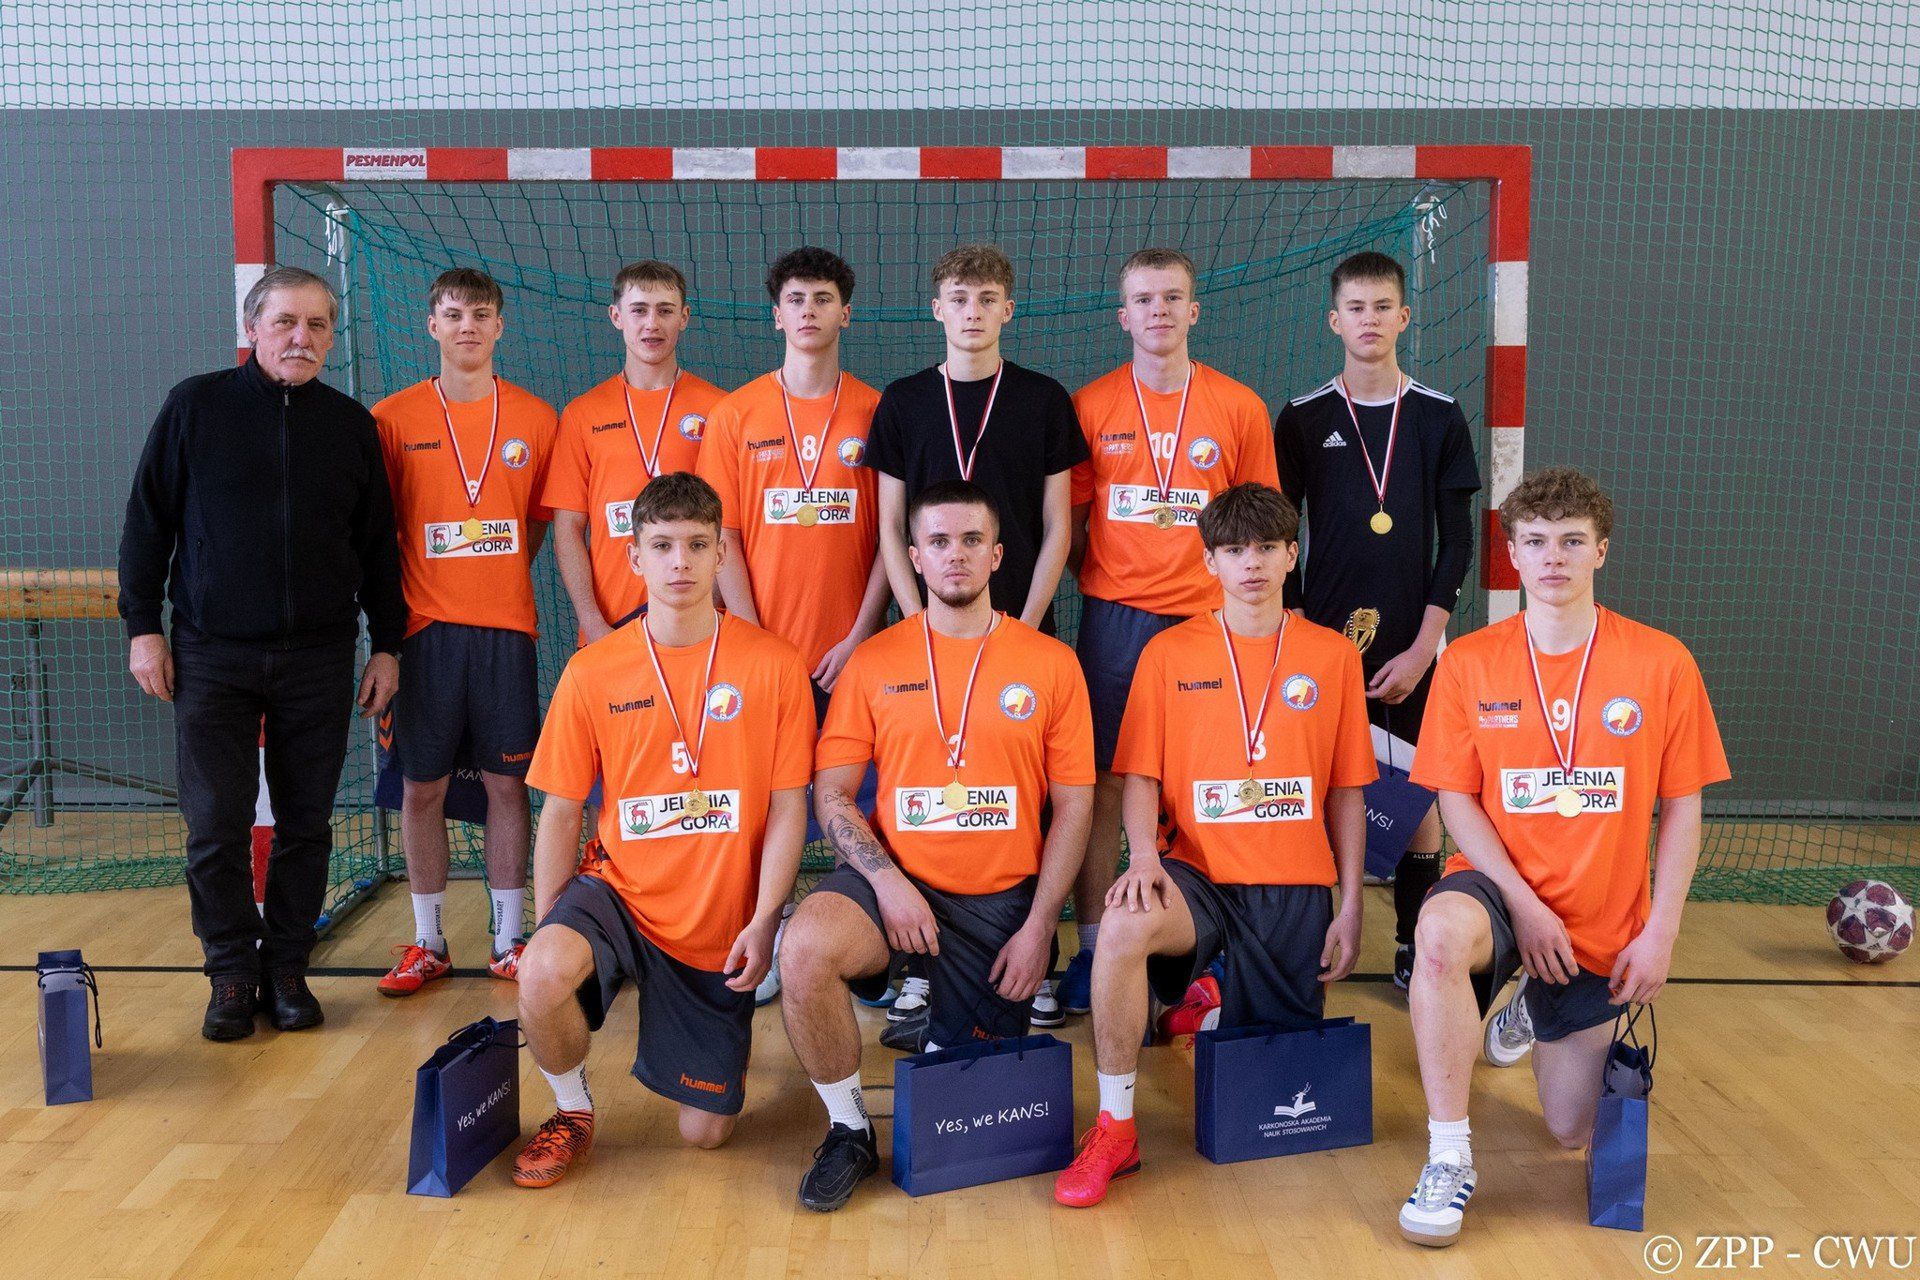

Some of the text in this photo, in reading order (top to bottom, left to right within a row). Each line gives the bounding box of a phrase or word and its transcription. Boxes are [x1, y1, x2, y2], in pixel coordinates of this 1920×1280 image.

[345, 154, 426, 167] PESMENPOL
[592, 420, 627, 434] hummel
[747, 436, 786, 450] hummel
[1100, 430, 1136, 442] hummel
[404, 440, 441, 451] hummel
[802, 434, 817, 461] 8
[1150, 431, 1176, 459] 10
[793, 490, 850, 504] JELENIA
[817, 505, 849, 521] ÓRA
[1171, 506, 1198, 522] ÓRA
[455, 522, 512, 537] JENIA
[472, 537, 513, 553] GÓRA
[884, 680, 929, 695] hummel
[1178, 677, 1223, 691] hummel
[609, 695, 655, 714] hummel
[1478, 699, 1522, 711] hummel
[1552, 698, 1571, 731] 9
[502, 752, 533, 763] humm
[671, 741, 690, 774] 5
[947, 734, 966, 767] 2
[936, 789, 1008, 806] JENIA
[1581, 789, 1617, 809] ÓRA
[1255, 799, 1304, 818] GÓRA
[956, 808, 1008, 828] GÓRA
[680, 1072, 727, 1094] hummel
[457, 1079, 511, 1131] Yes, we KANS!
[935, 1101, 1049, 1135] Yes, we KANS!
[1258, 1115, 1332, 1131] KARKONOSKA AKADEMIA
[1263, 1124, 1328, 1138] NAUK STOSOWANYCH
